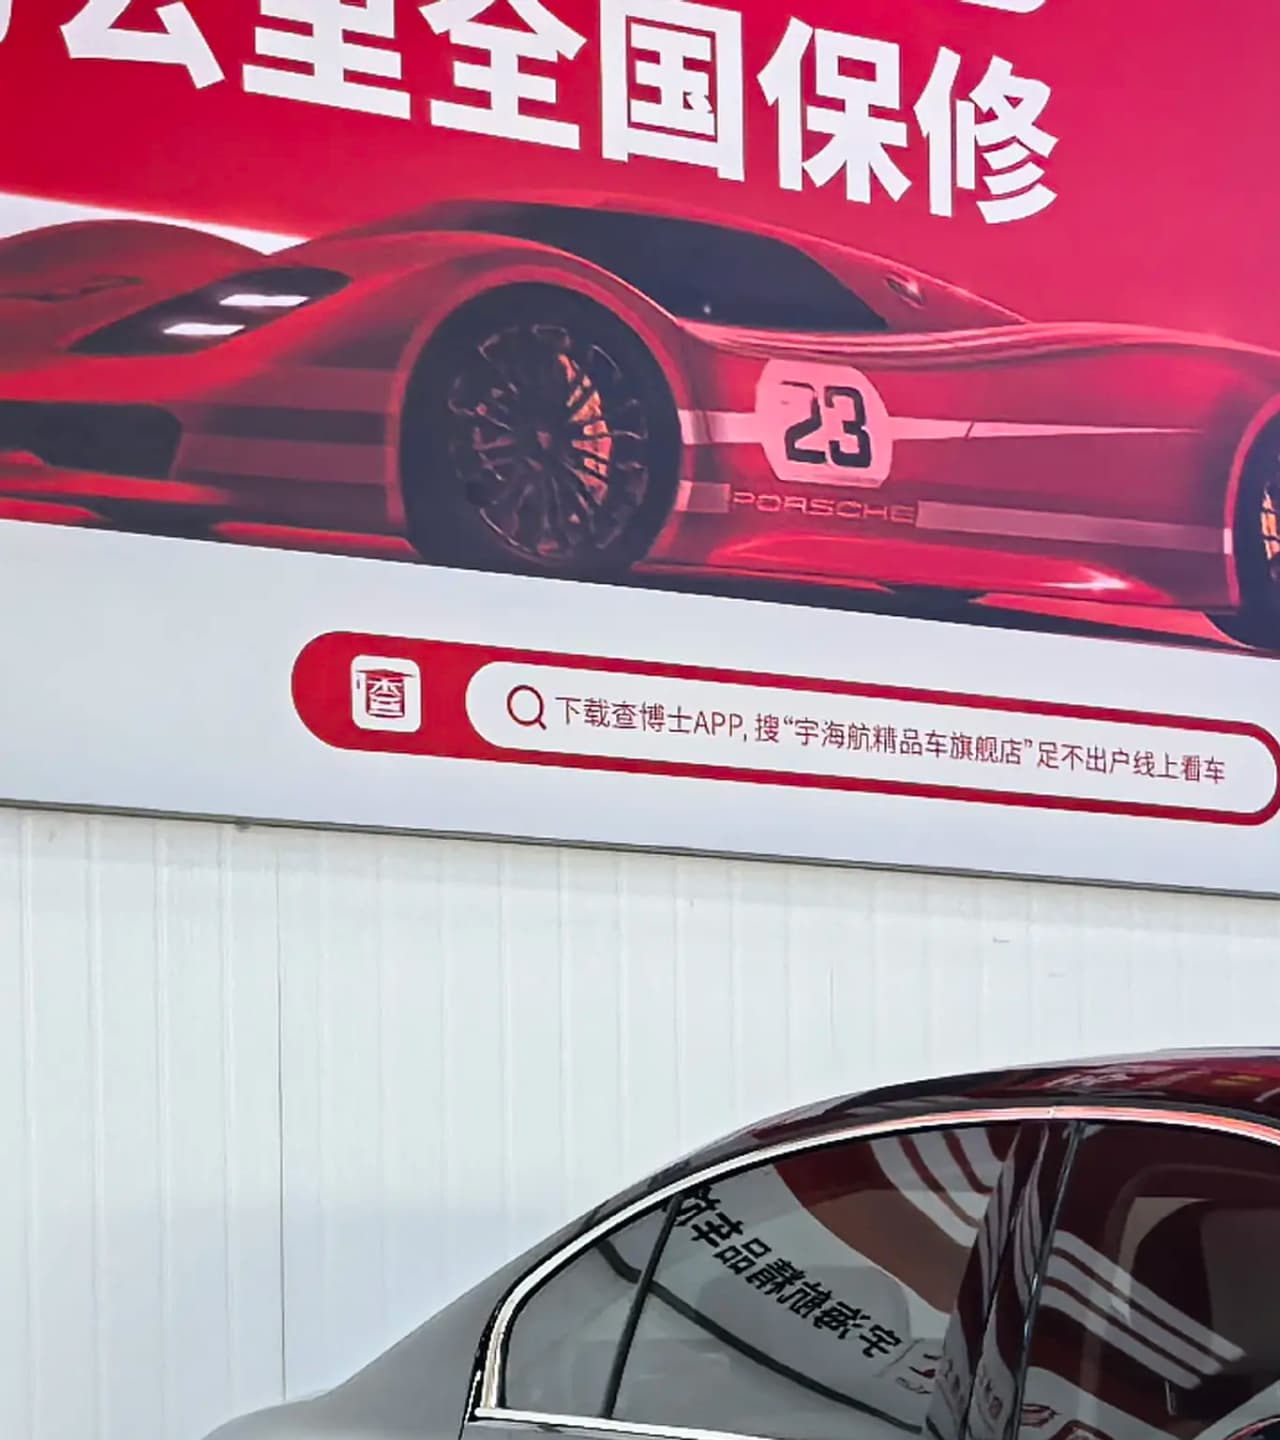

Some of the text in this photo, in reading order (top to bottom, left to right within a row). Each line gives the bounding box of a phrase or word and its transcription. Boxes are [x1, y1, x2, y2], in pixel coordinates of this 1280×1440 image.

[0, 0, 1058, 224] 公里全国保修
[780, 381, 872, 469] 23
[732, 491, 916, 524] PORSCHE
